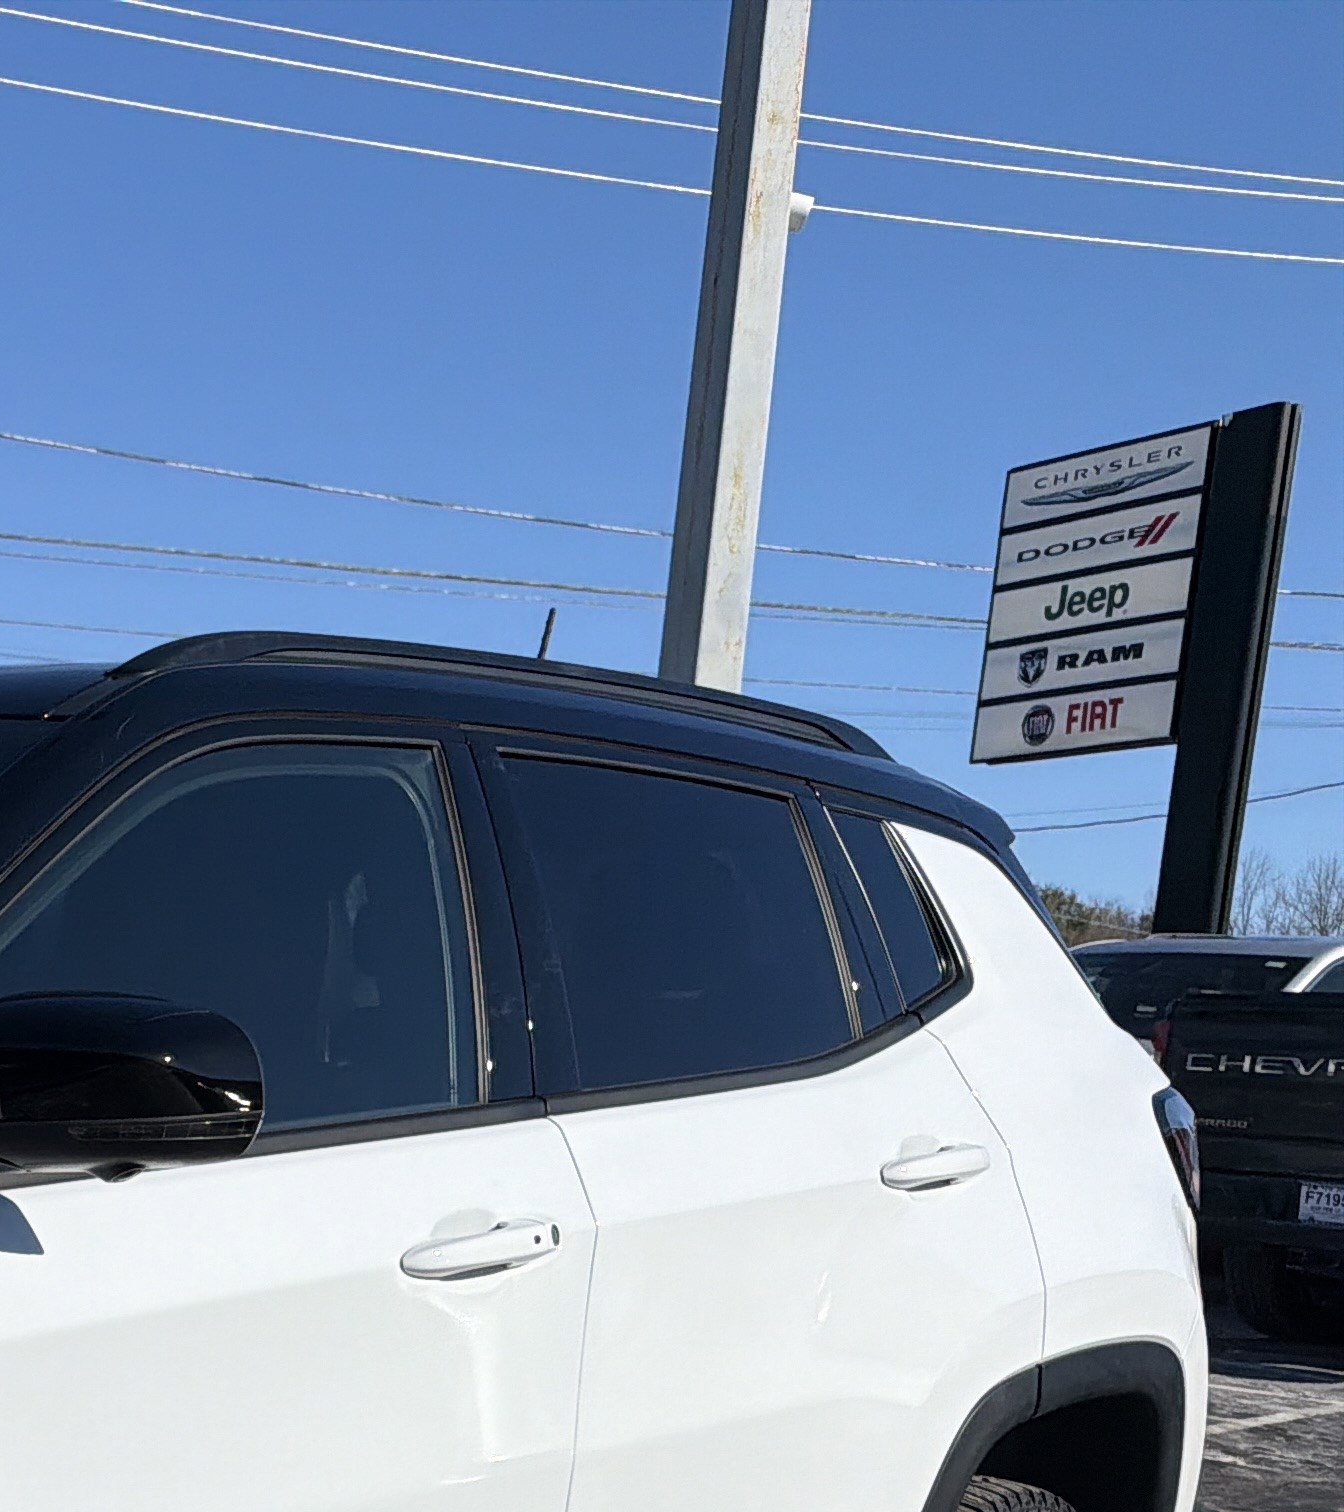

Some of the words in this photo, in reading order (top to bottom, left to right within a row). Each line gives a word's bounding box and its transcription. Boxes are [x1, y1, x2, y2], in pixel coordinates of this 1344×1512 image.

[1034, 445, 1183, 489] CHRYSLER
[1016, 524, 1154, 563] DODGE
[1044, 582, 1130, 621] Jeep
[1056, 642, 1145, 671] RAM
[1065, 696, 1124, 735] FIAT
